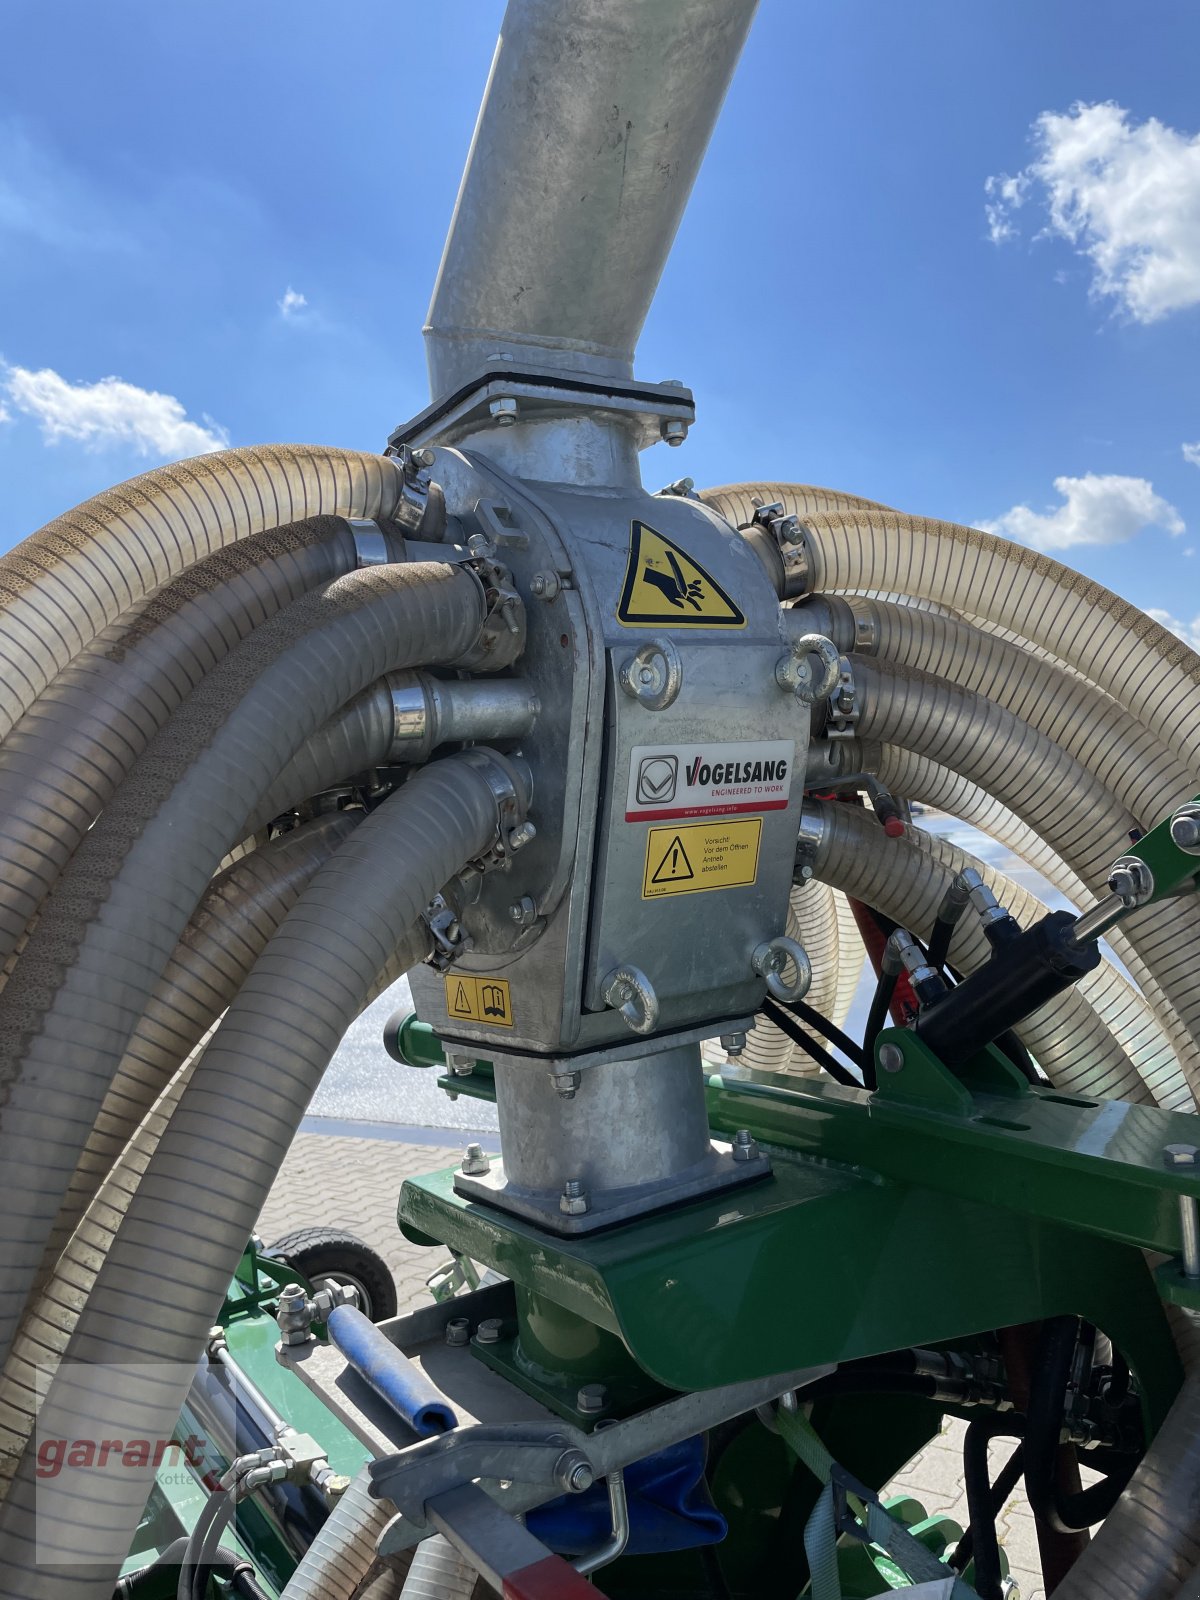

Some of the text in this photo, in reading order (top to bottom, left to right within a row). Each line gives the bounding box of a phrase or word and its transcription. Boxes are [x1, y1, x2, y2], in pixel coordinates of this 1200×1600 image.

[686, 757, 787, 786] VOGELSANG
[711, 785, 784, 797] ENGINEERED TO WORK
[704, 837, 730, 845] Vorsicht!
[703, 846, 714, 854] Vor
[729, 842, 749, 851] Öffnen
[702, 854, 724, 863] Antrieb
[701, 863, 728, 873] abstellen
